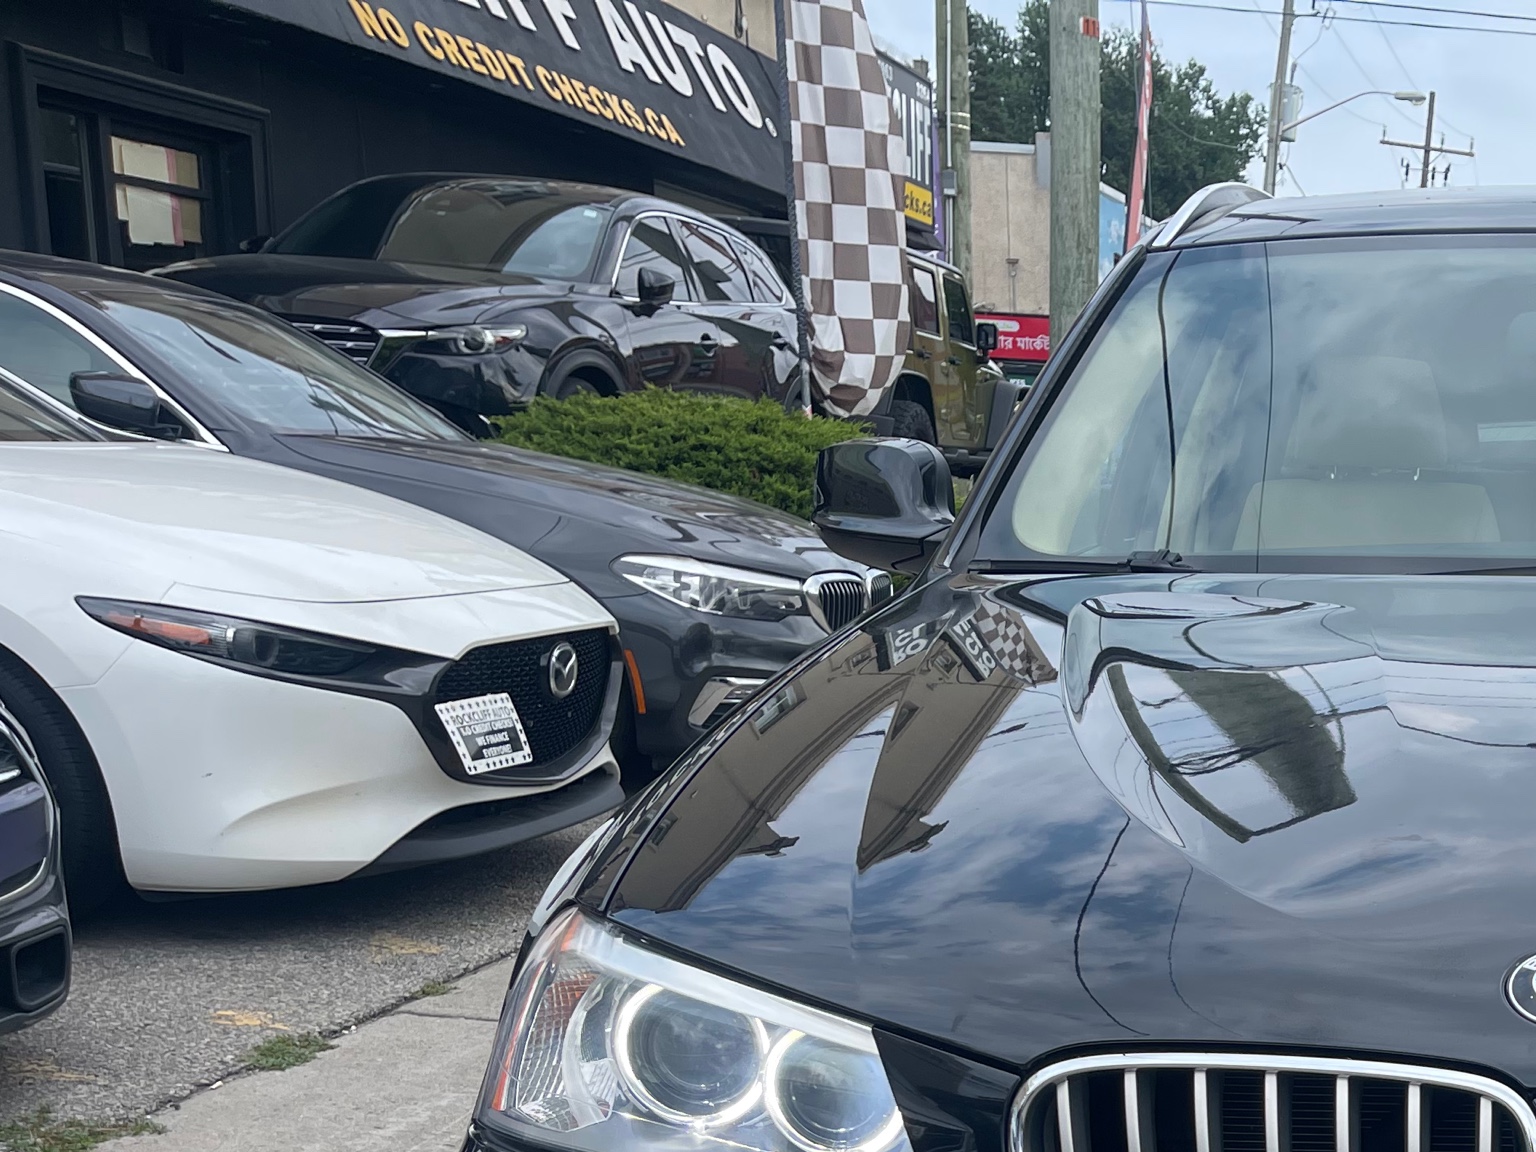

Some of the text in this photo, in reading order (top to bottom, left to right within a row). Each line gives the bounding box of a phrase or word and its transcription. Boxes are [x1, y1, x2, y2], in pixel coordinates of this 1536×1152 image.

[348, 0, 410, 48] NO
[412, 21, 535, 91] CREDIT
[533, 64, 687, 146] CHECKS.CA
[450, 706, 511, 726] ROCKCLIFF AUTO
[476, 731, 510, 746] WE FINANCE
